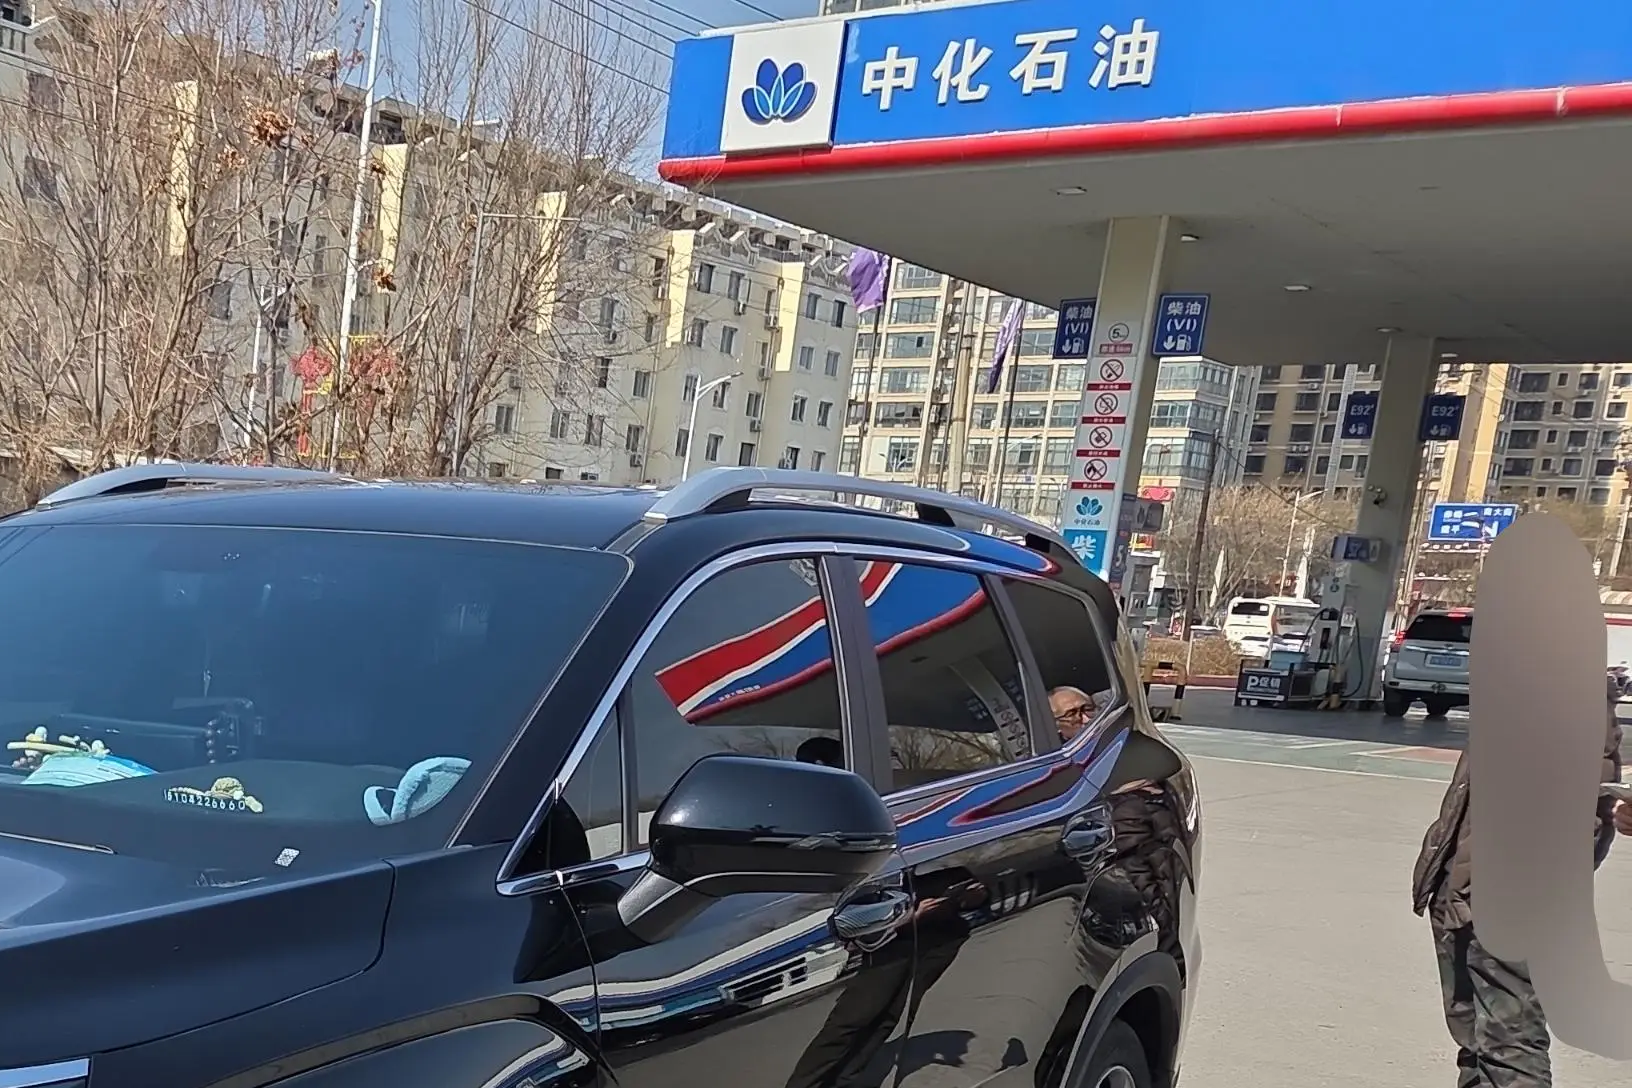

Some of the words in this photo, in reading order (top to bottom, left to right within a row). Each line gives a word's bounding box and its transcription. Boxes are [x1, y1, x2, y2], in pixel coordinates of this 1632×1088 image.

[862, 18, 1160, 110] 中化石油
[1066, 305, 1093, 320] 柴油
[1167, 301, 1202, 316] 柴油
[1072, 534, 1097, 560] 柴
